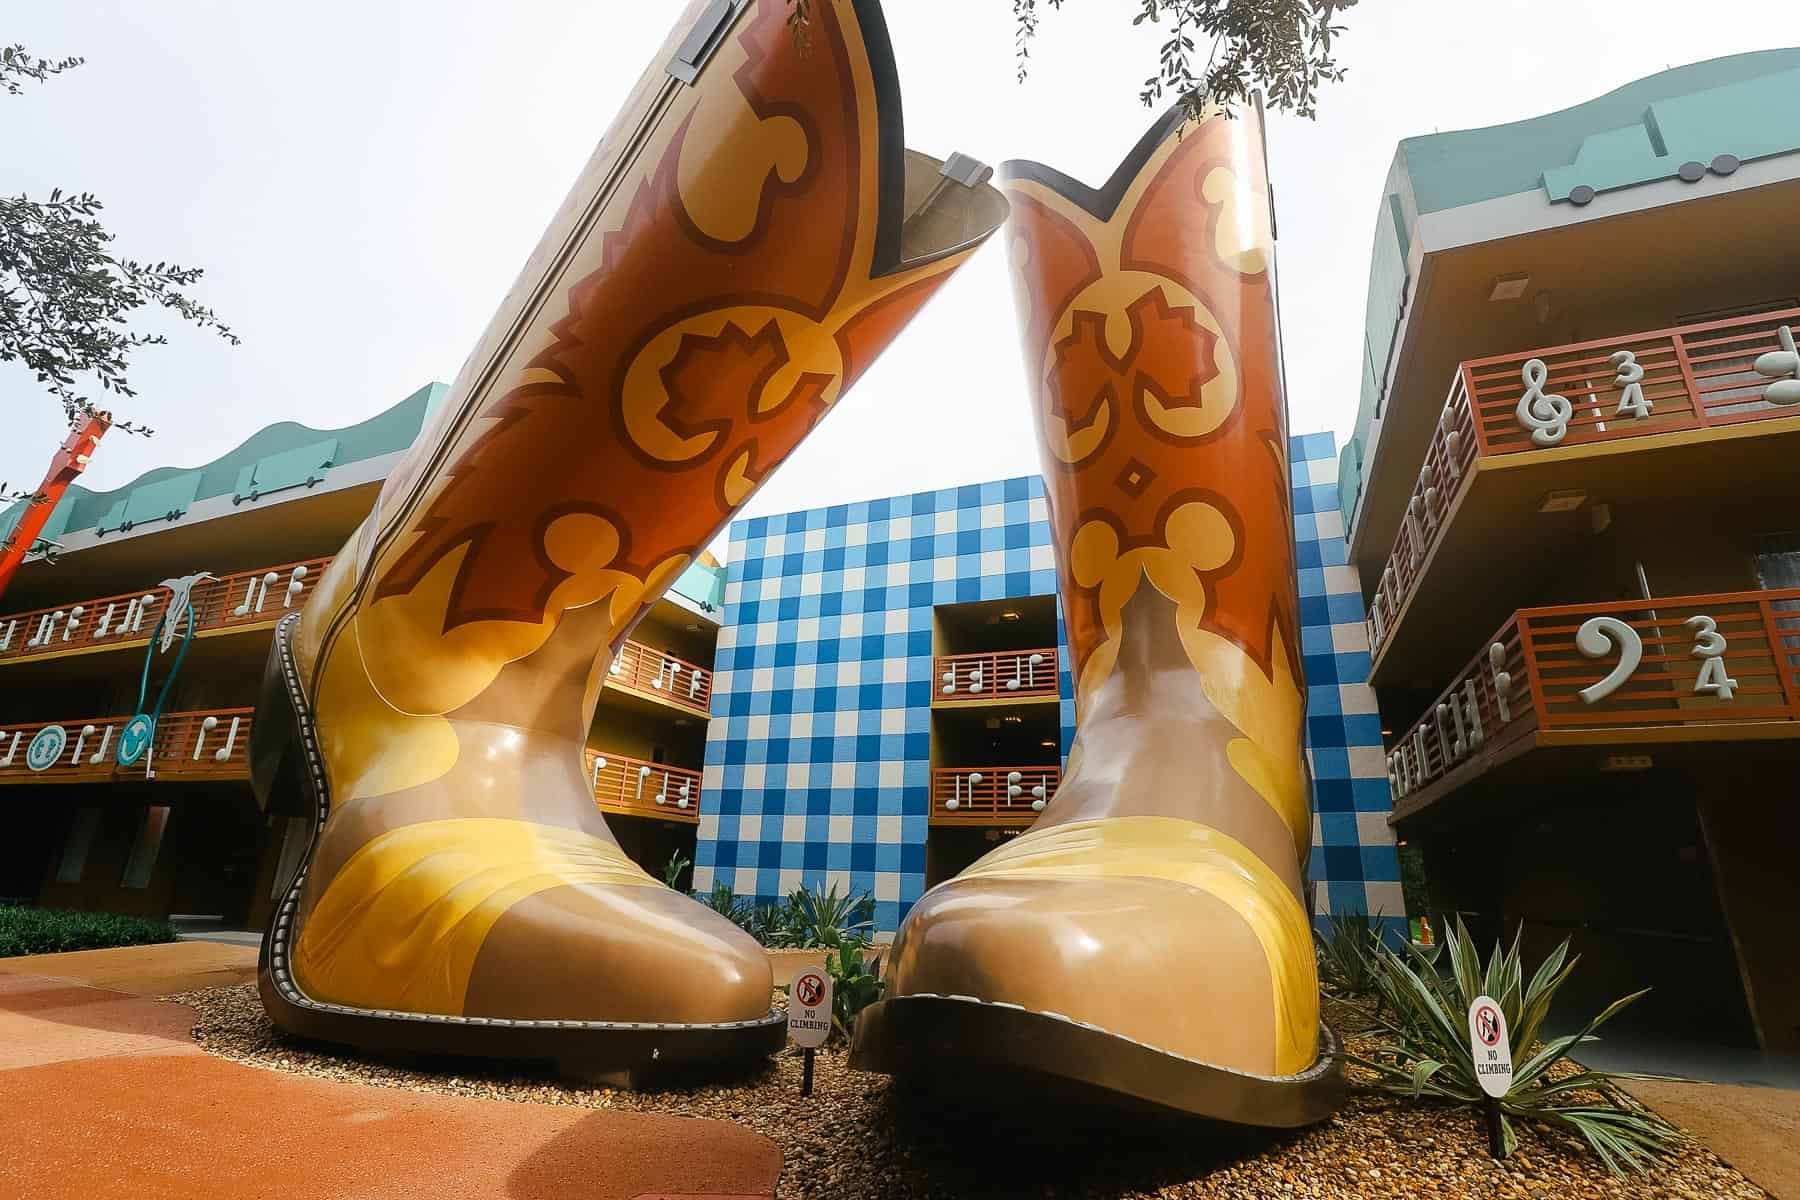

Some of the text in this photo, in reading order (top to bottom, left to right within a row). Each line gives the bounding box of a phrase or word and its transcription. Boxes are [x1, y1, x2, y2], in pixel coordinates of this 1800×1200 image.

[1610, 350, 1645, 385] 3
[1616, 383, 1654, 418] 4
[1685, 615, 1727, 656] 3
[1695, 657, 1738, 702] 4
[790, 1019, 829, 1031] CLIMBING
[804, 1009, 816, 1018] NO
[1487, 1049, 1498, 1061] NO
[1477, 1063, 1511, 1075] CLIMBING
